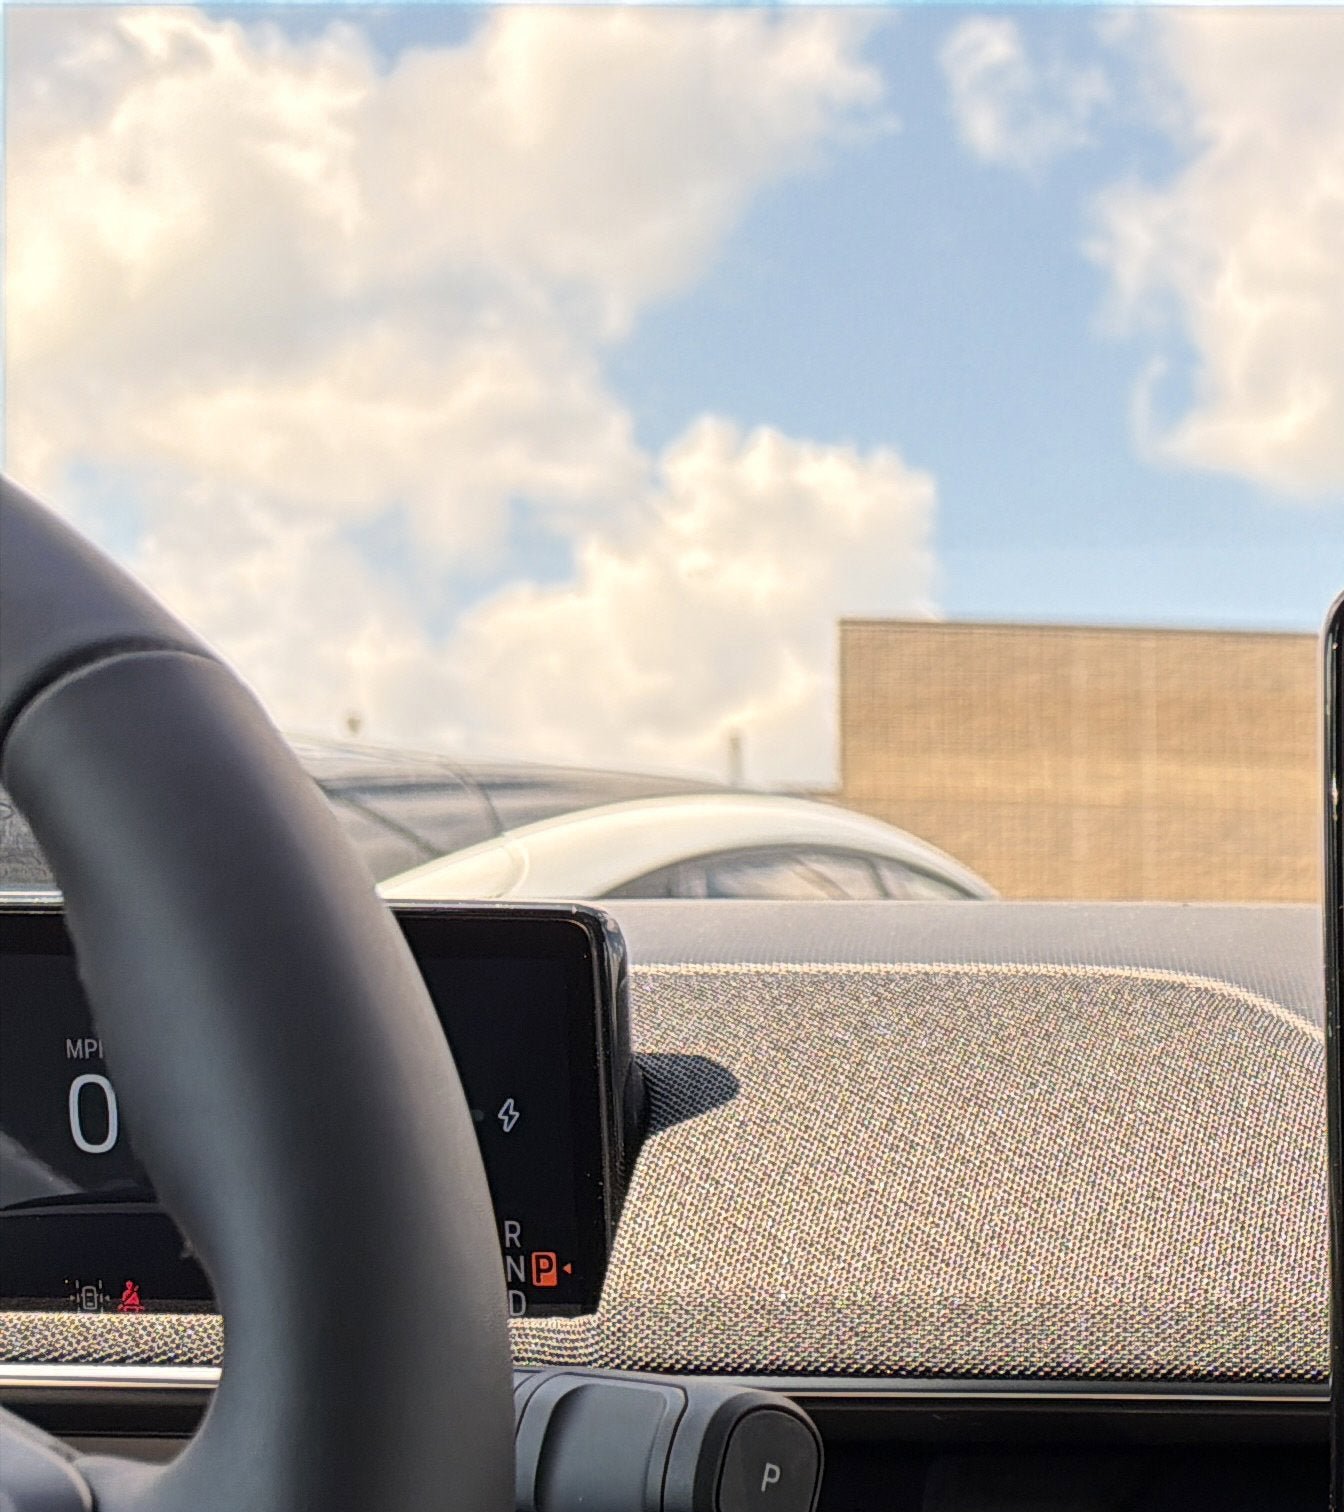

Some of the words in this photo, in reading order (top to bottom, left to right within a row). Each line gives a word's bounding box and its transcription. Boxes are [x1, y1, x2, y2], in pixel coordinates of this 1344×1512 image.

[68, 1073, 119, 1154] 0
[504, 1220, 521, 1248] R
[506, 1255, 526, 1283] N
[534, 1254, 553, 1284] P
[508, 1290, 527, 1317] D
[760, 1463, 781, 1493] P
